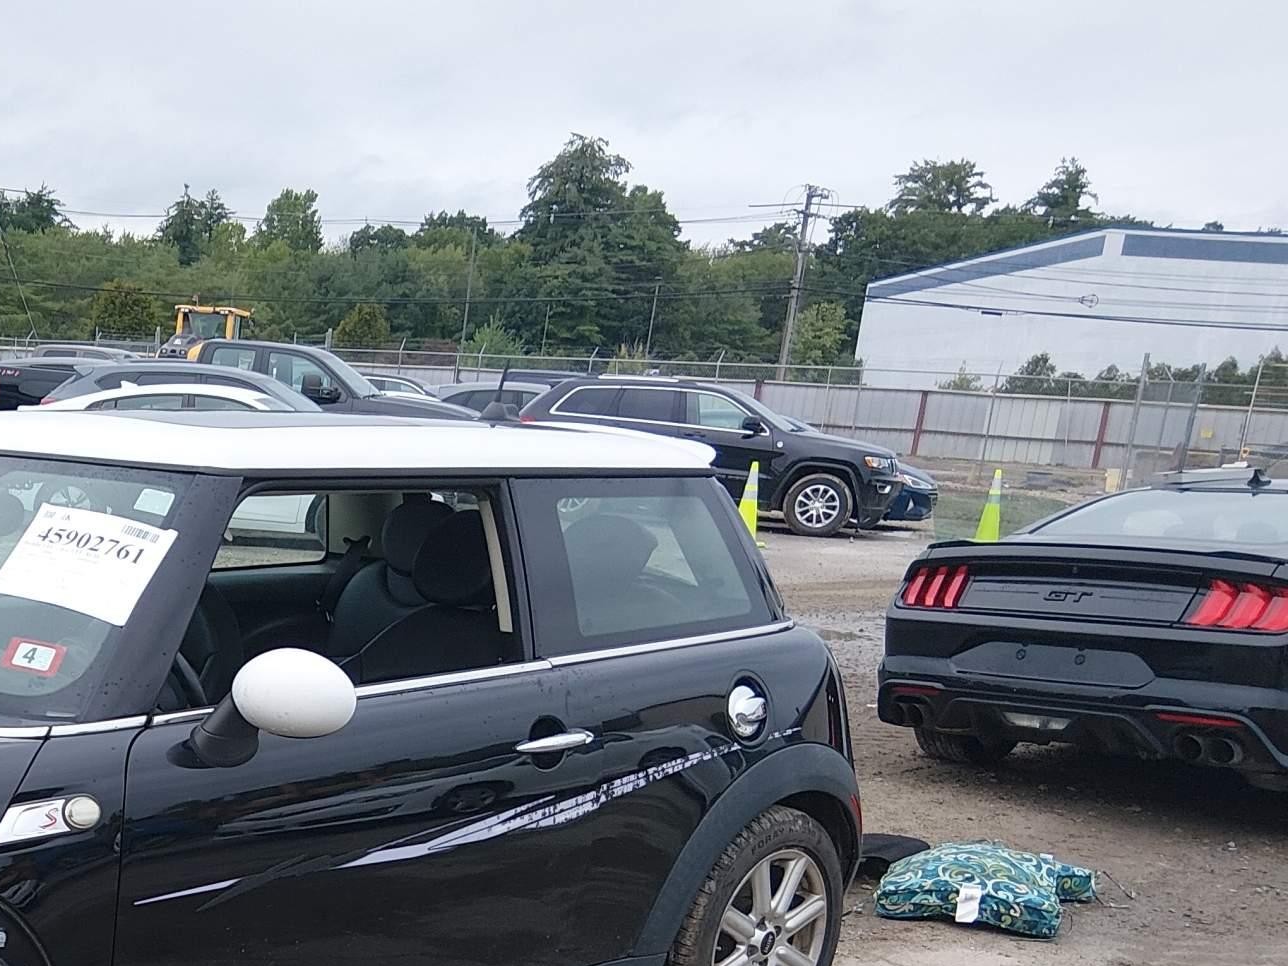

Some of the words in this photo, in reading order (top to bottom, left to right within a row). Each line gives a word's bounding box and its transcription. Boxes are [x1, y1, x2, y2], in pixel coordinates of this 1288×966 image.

[38, 526, 145, 565] 45902761
[1043, 589, 1094, 603] GT
[22, 647, 38, 664] 4
[39, 807, 59, 830] S
